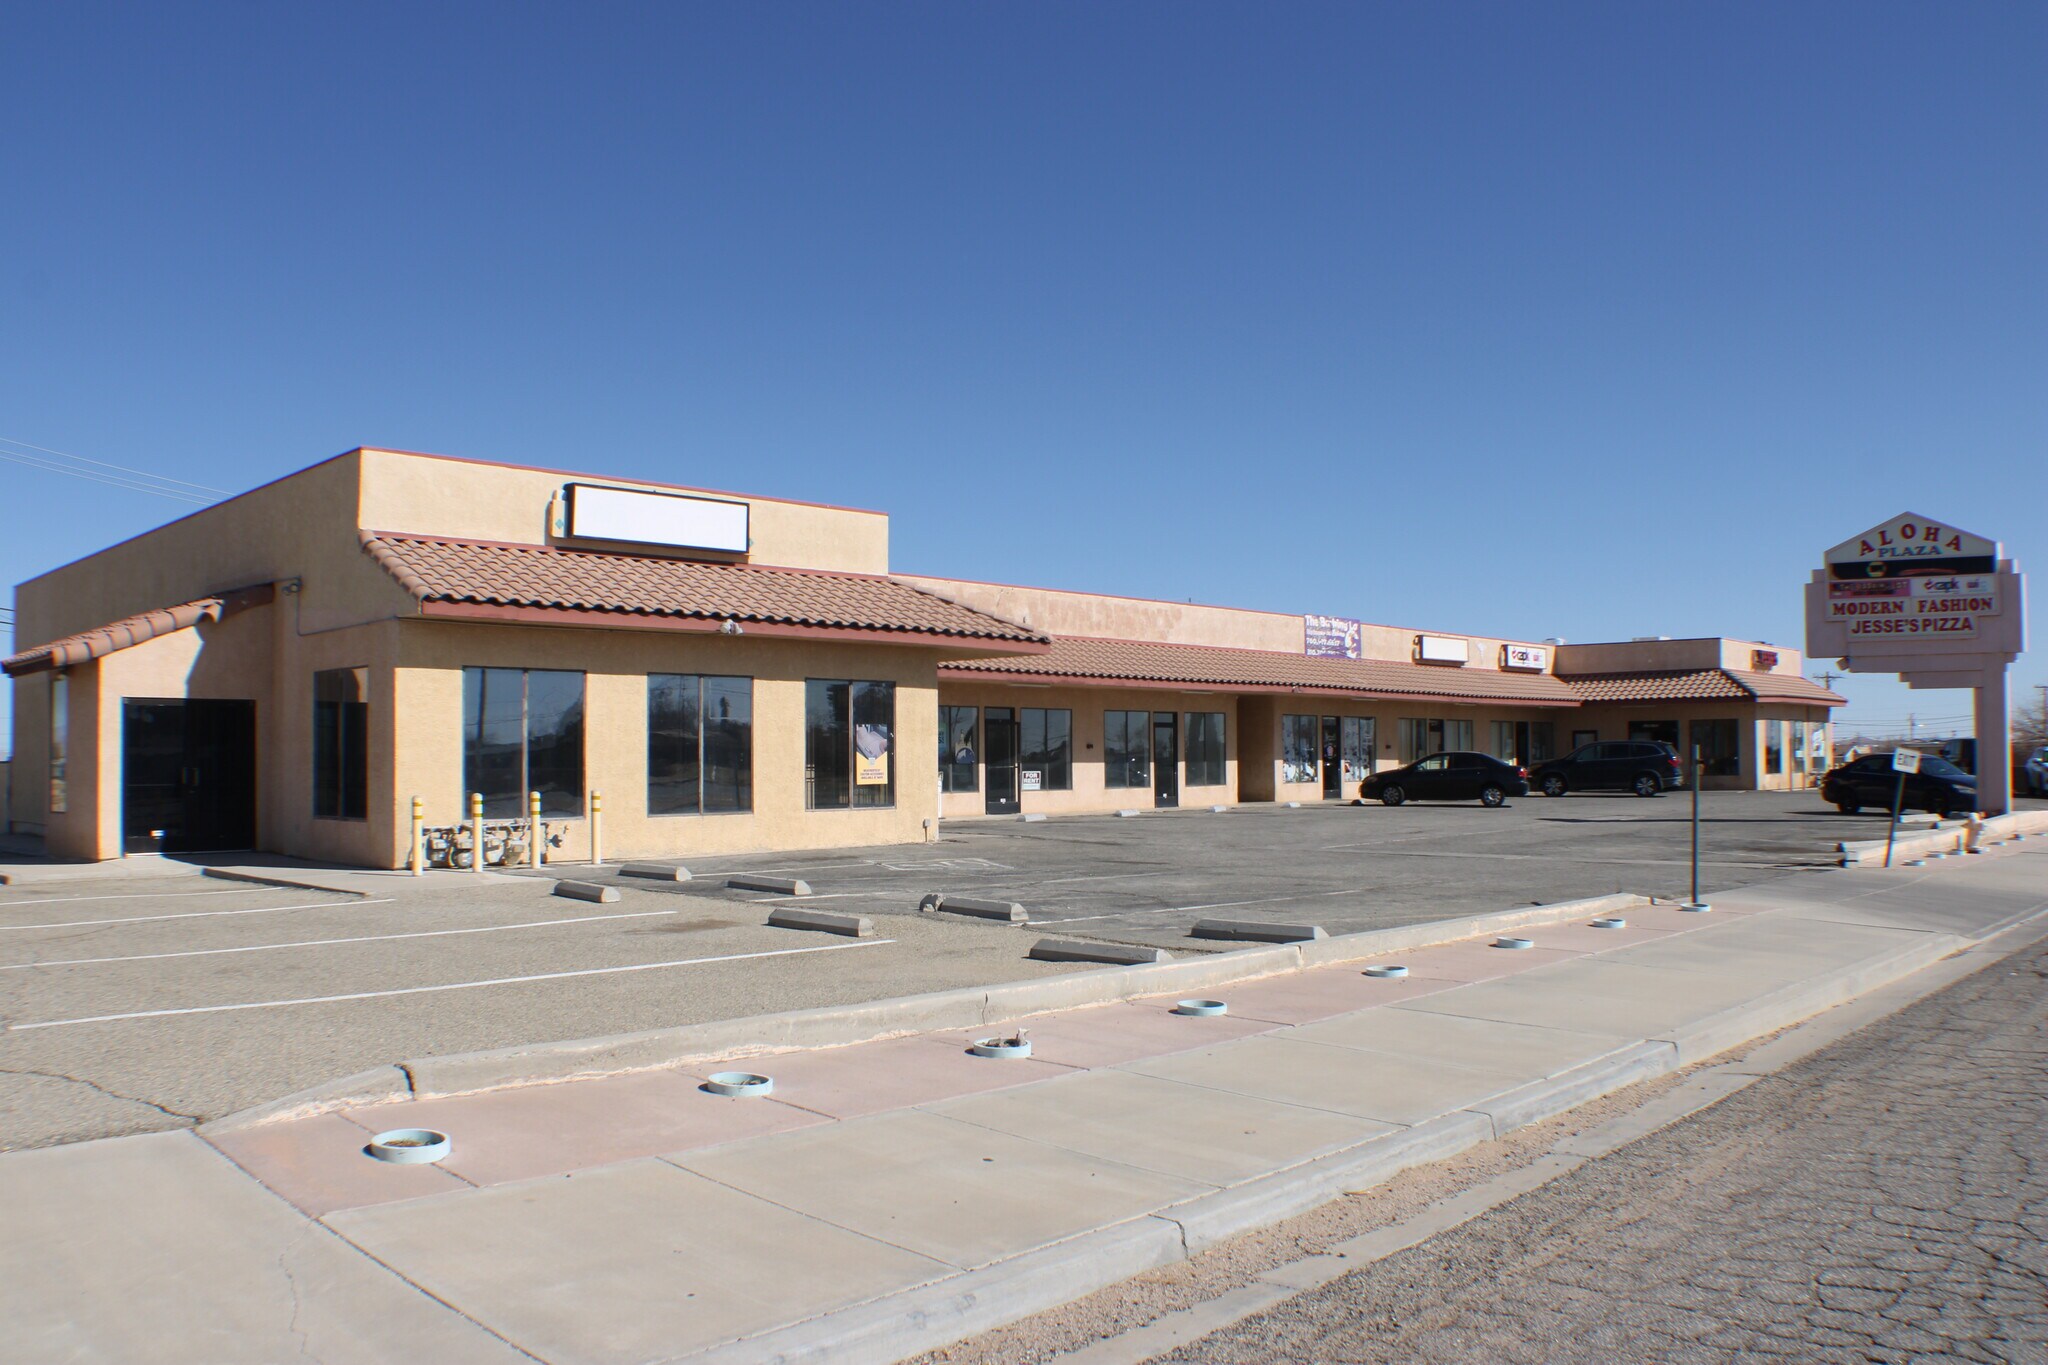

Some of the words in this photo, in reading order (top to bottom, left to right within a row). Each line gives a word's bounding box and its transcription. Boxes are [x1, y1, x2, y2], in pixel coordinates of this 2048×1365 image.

[1859, 523, 1963, 556] ALOHA
[1878, 545, 1943, 558] PLAZA
[1832, 600, 1904, 616] MODERN
[1917, 597, 1993, 613] FASHION
[1851, 617, 1919, 634] JESSE'S
[1922, 616, 1973, 632] PIZZA
[1897, 752, 1916, 767] EXIT
